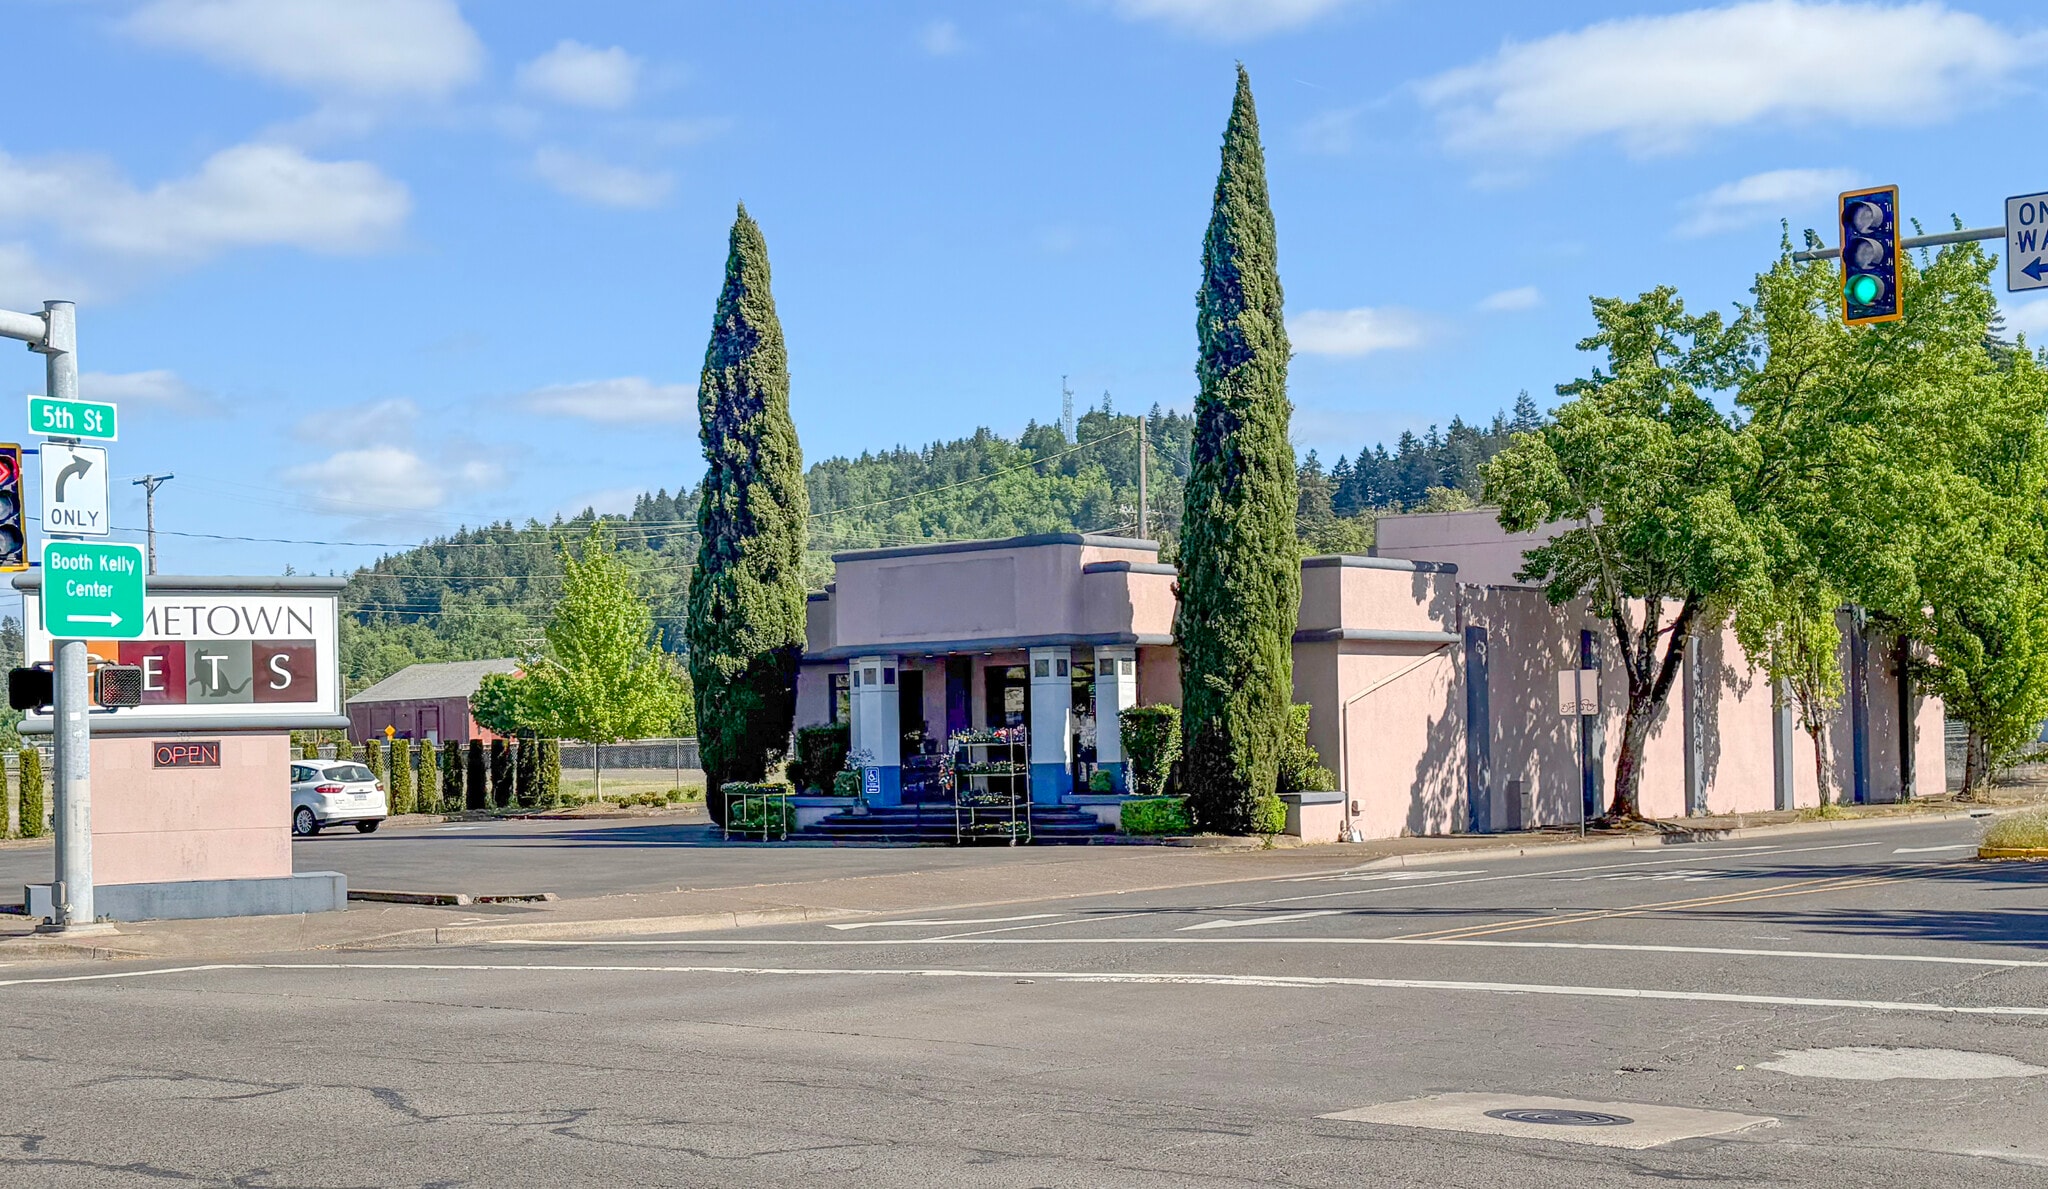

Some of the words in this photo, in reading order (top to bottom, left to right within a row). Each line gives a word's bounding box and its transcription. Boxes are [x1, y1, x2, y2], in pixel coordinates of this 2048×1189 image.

[43, 405, 74, 430] 5th
[84, 409, 103, 432] St
[51, 508, 99, 527] ONLY
[51, 552, 93, 571] Booth
[100, 555, 135, 576] Kelly
[66, 579, 113, 598] Center
[157, 745, 217, 764] OPEN
